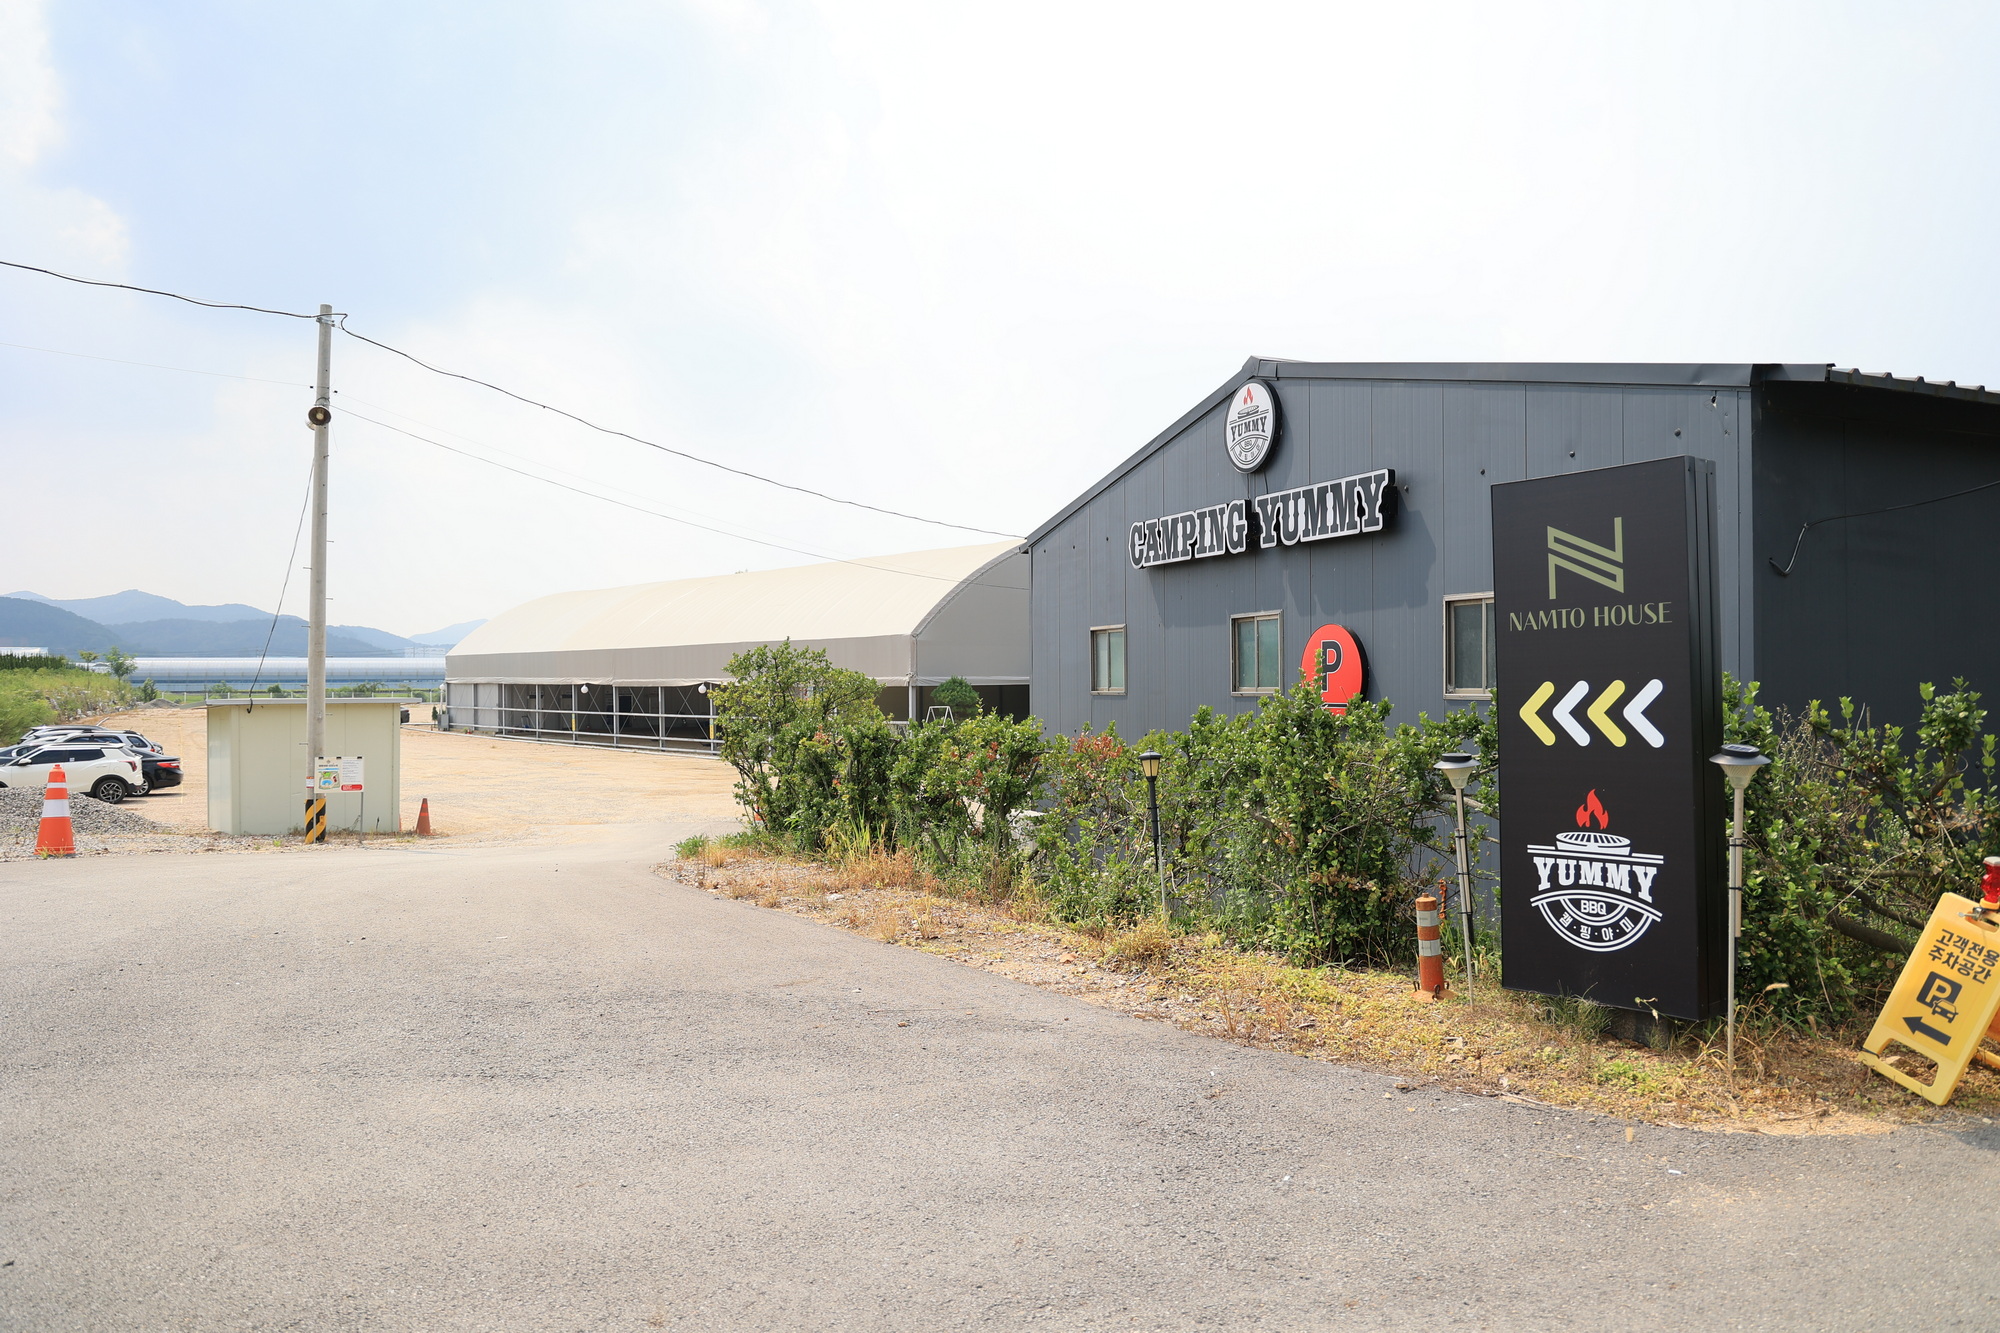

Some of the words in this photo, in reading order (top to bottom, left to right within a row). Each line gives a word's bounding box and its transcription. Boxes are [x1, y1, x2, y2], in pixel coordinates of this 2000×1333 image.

[1230, 415, 1268, 442] YUMMY
[1129, 499, 1248, 569] CAMPING
[1255, 469, 1389, 549] YUMMY
[1509, 607, 1586, 632] NAMTO
[1594, 601, 1673, 627] HOUSE
[1320, 639, 1344, 693] P
[1532, 856, 1658, 904] YUMMY
[1580, 899, 1607, 916] BBQ
[1928, 944, 1992, 985] 주차공간
[1935, 928, 2000, 968] 고객전용
